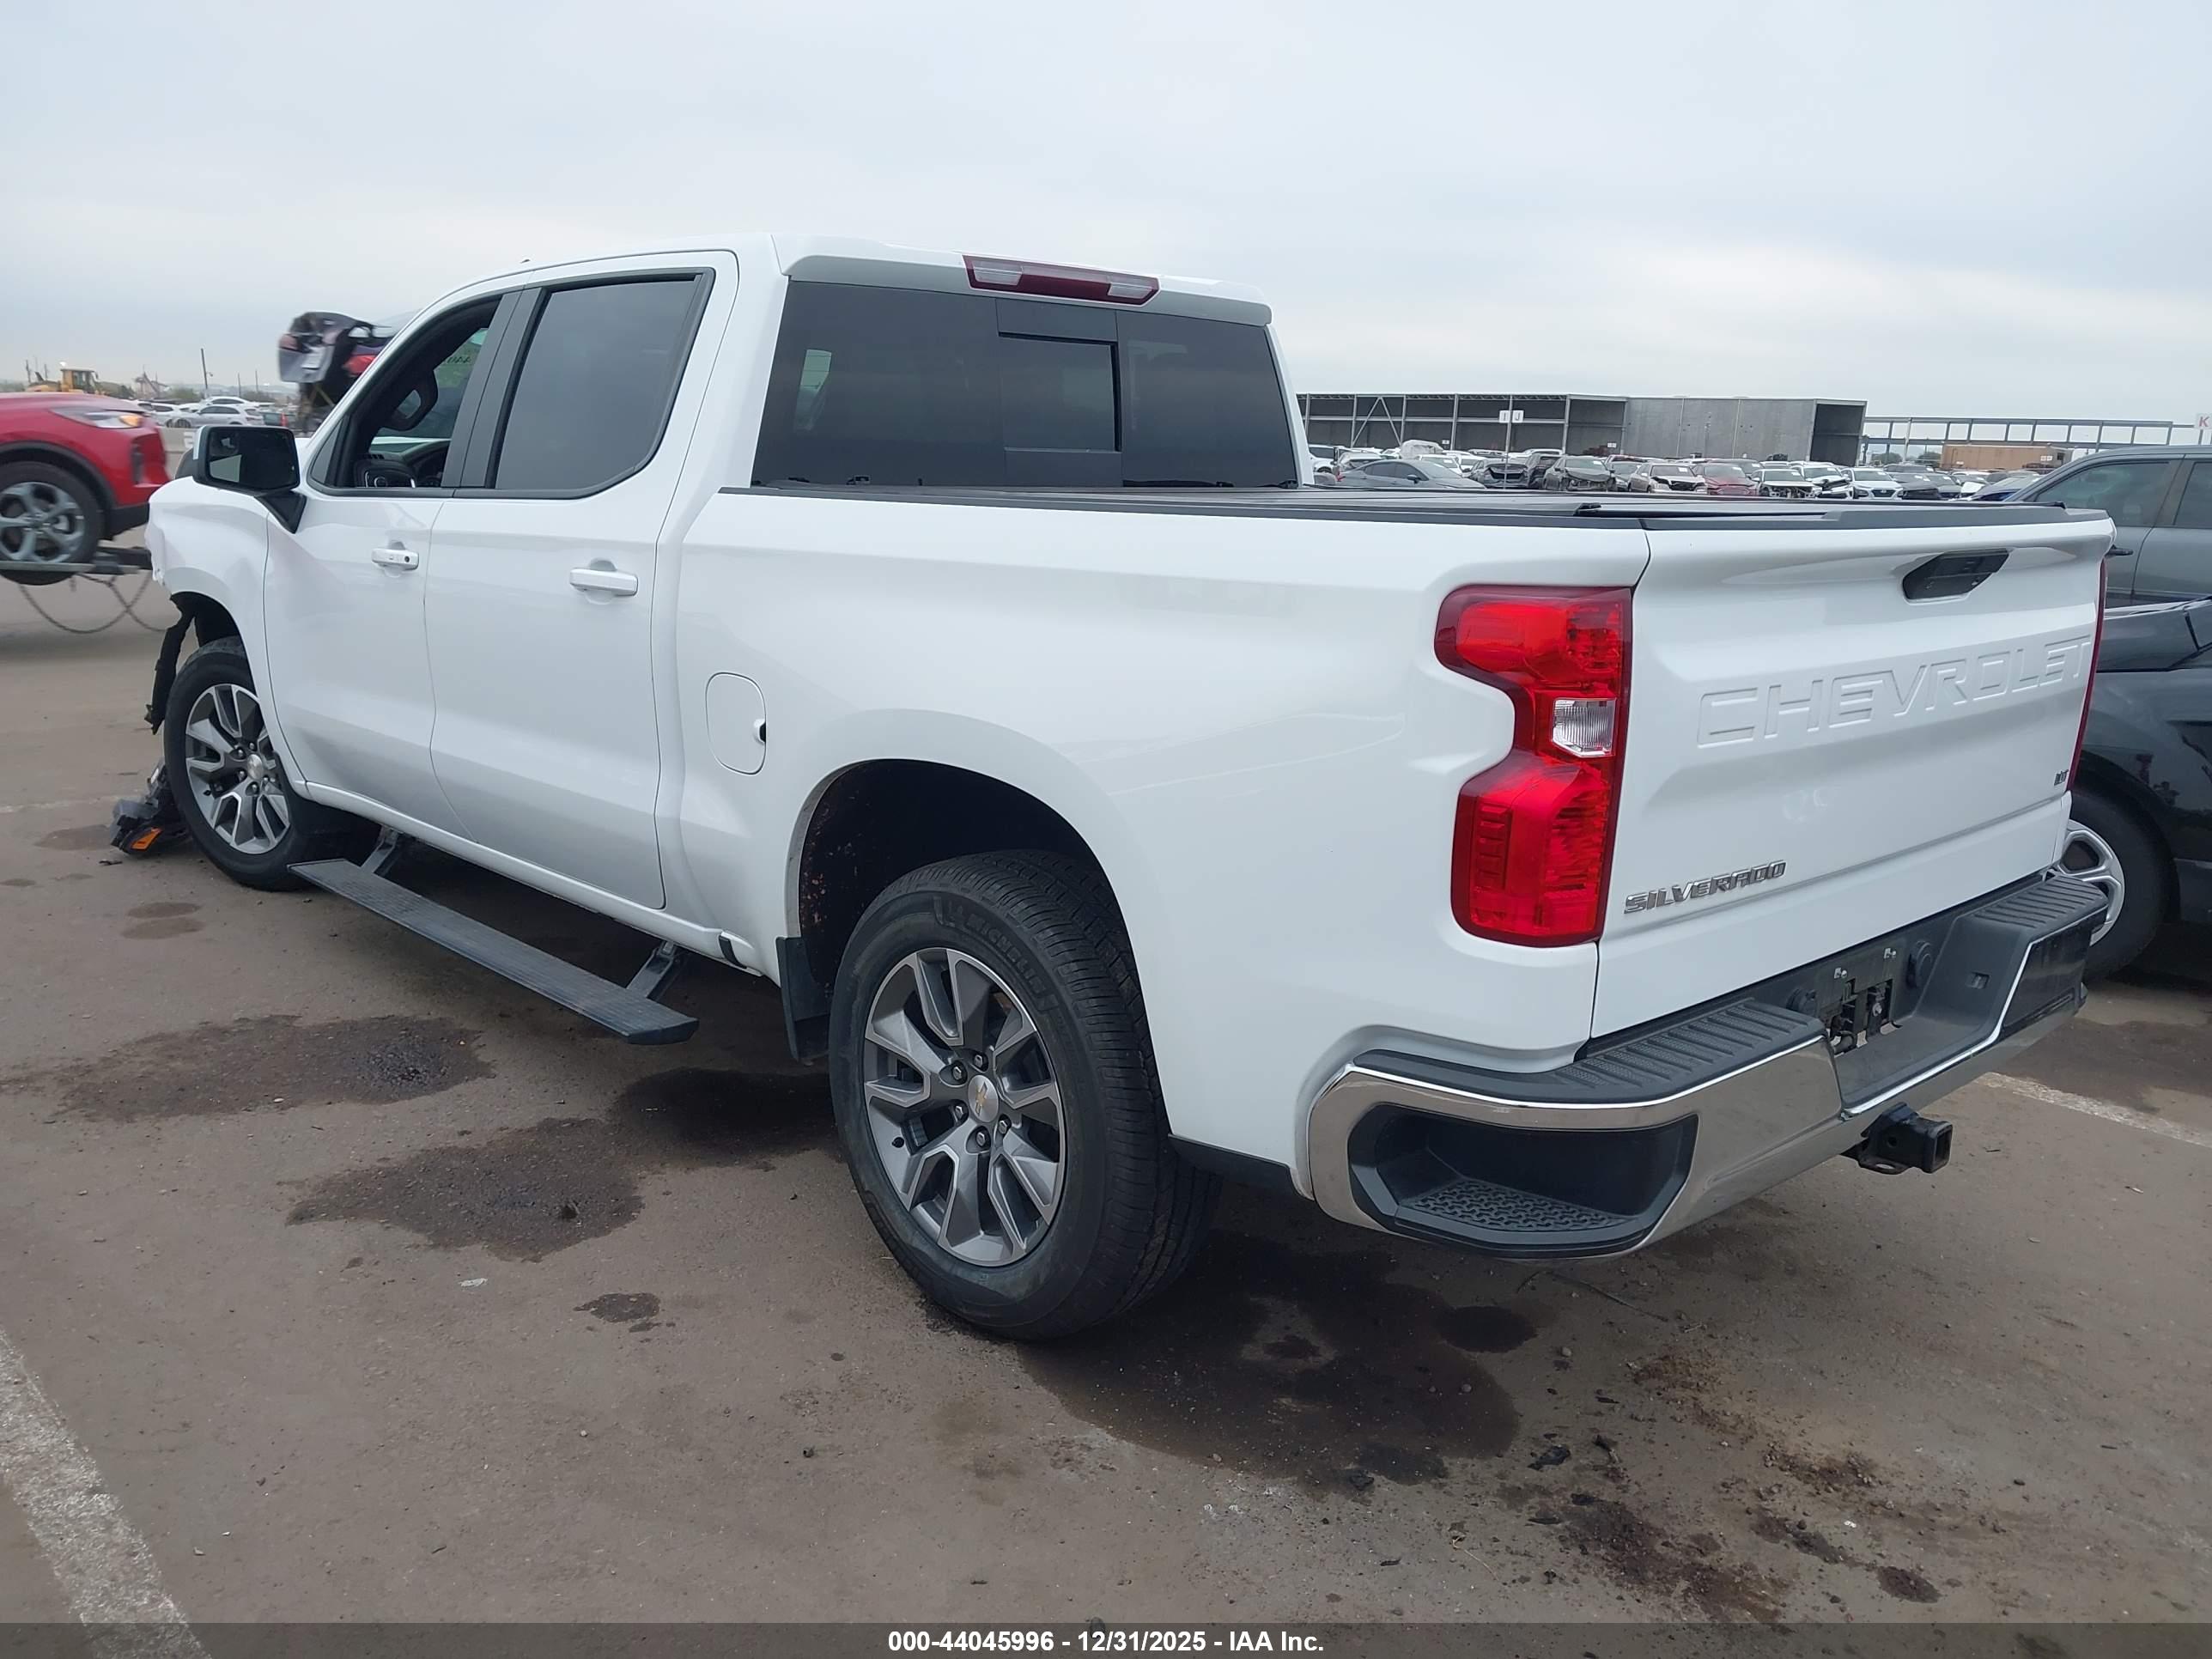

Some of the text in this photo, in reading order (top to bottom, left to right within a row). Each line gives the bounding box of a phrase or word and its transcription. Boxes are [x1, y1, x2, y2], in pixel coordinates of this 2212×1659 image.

[2199, 416, 2210, 428] K
[1697, 634, 2092, 748] CHEVROLET
[1623, 860, 1787, 914] SILVERADO
